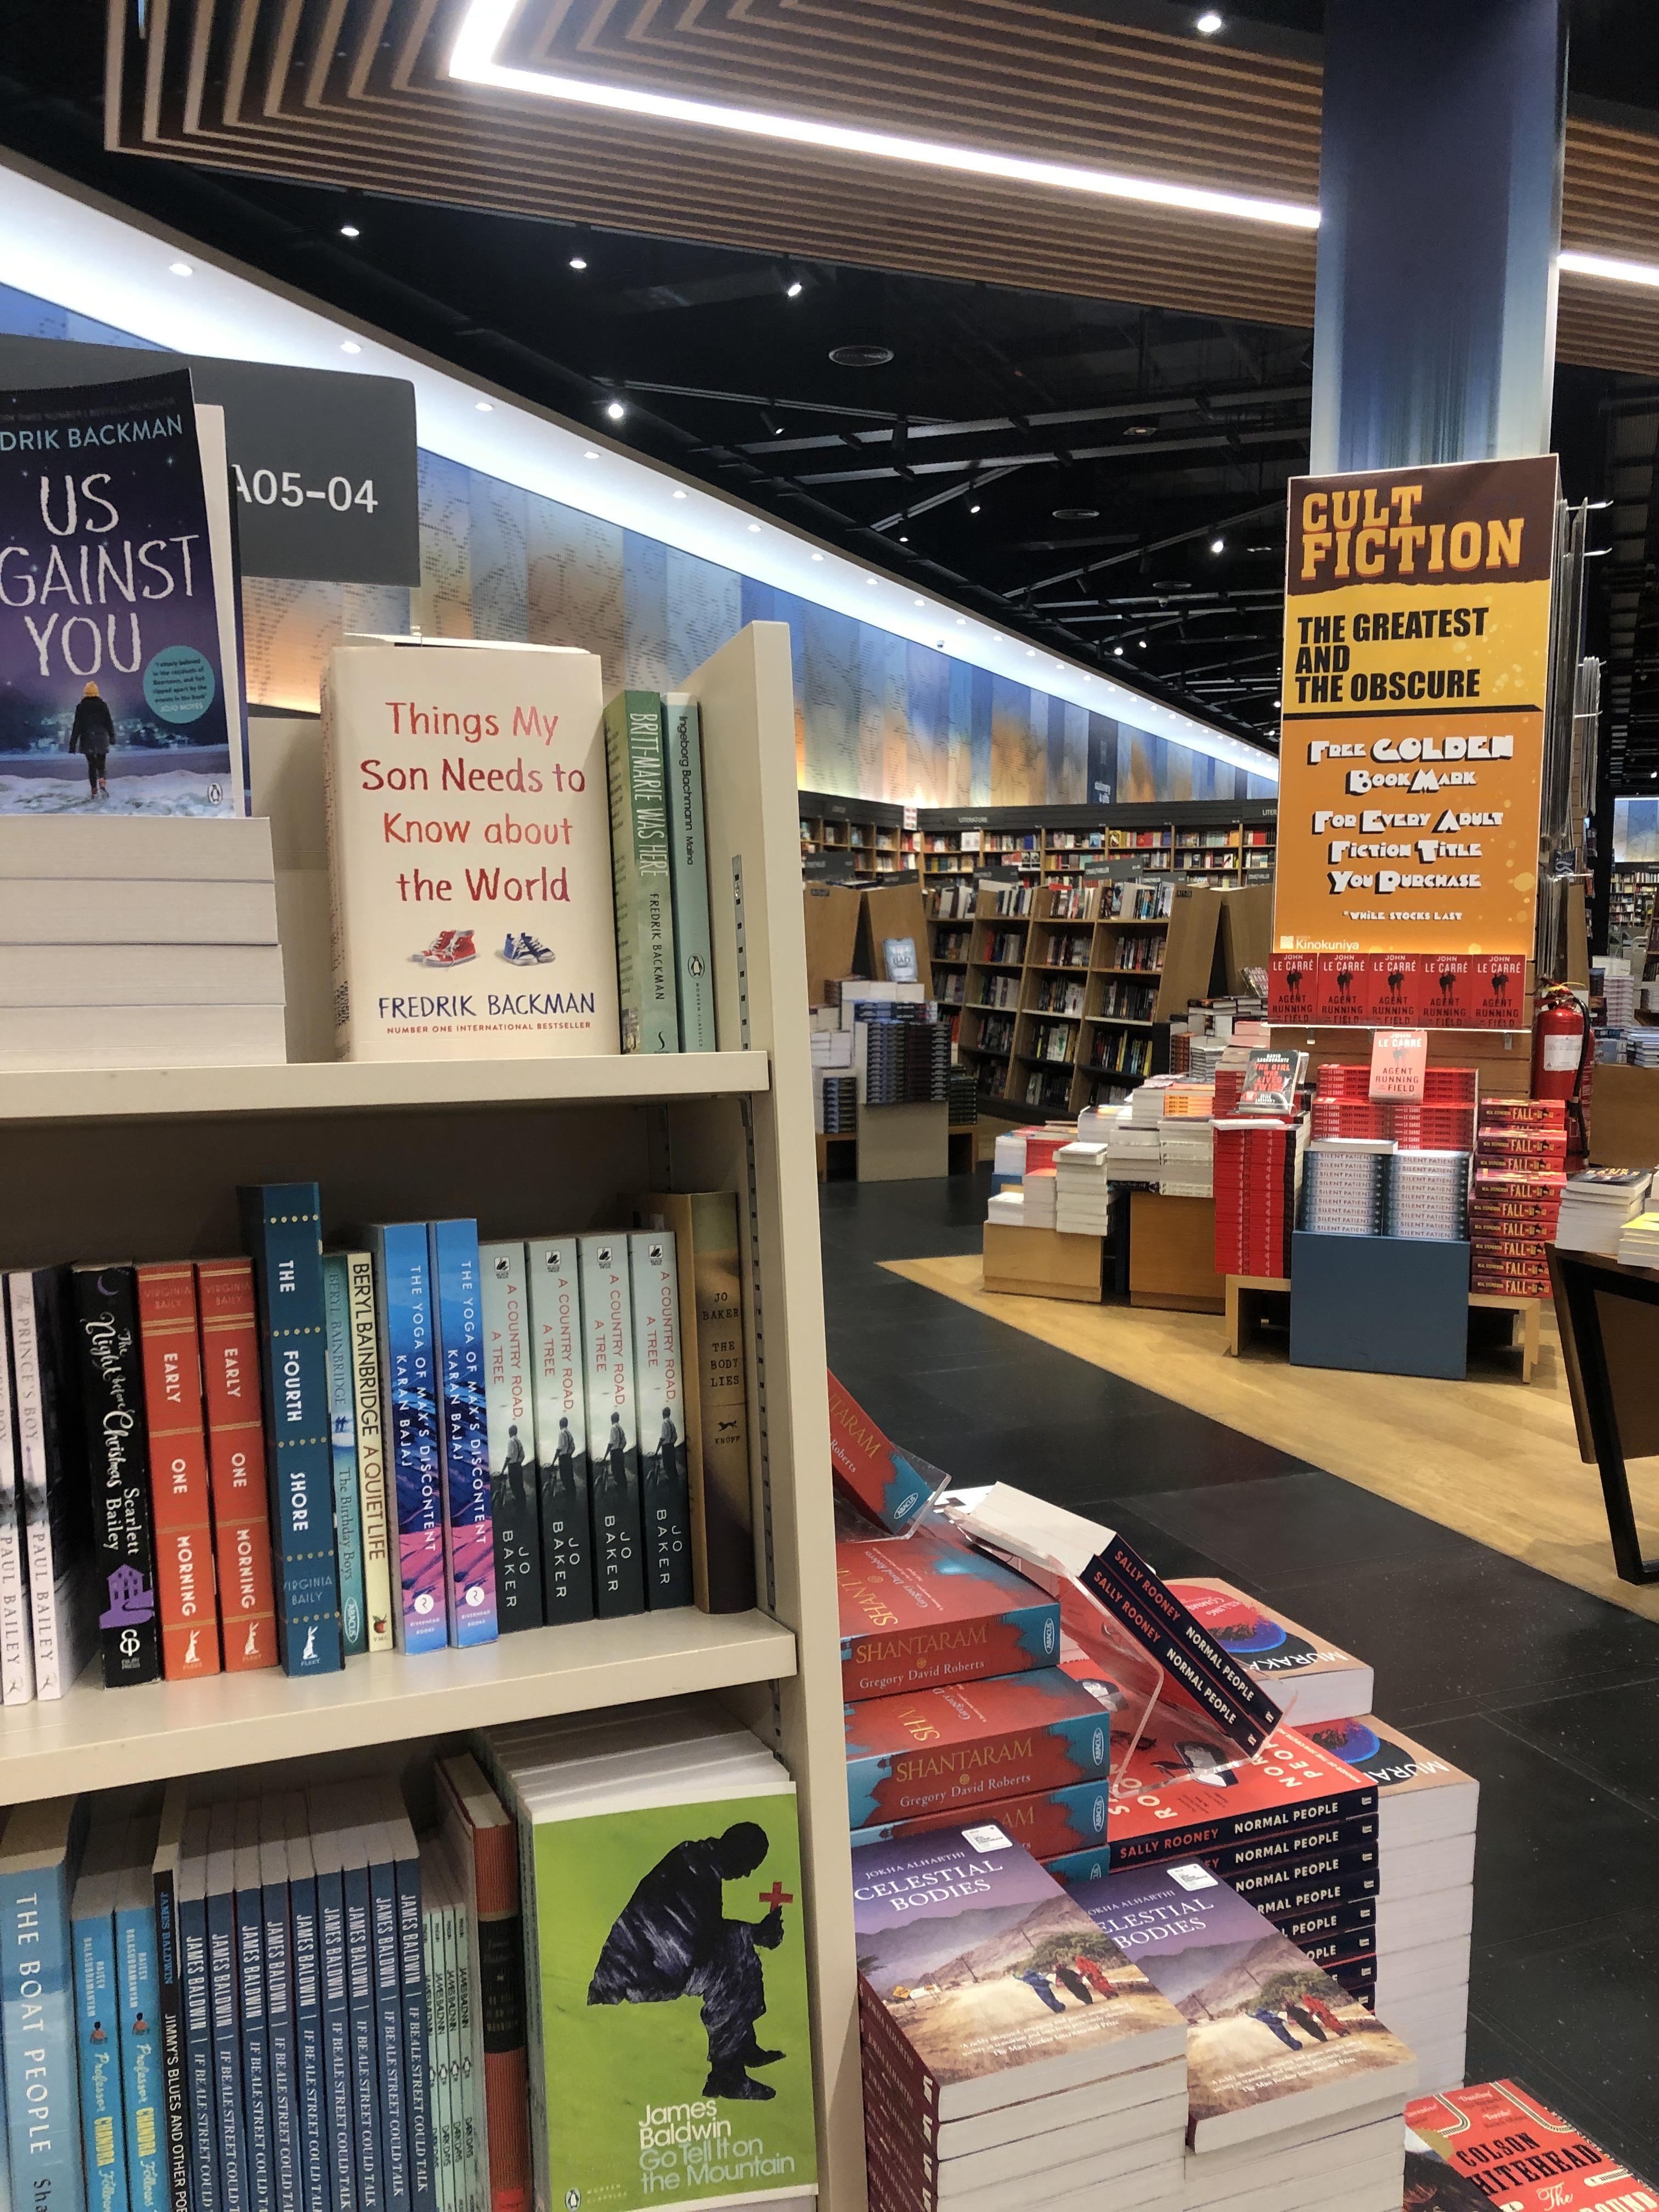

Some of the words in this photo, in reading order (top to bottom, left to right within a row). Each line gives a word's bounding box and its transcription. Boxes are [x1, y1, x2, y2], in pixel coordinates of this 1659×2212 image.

[68, 414, 183, 448] BACKMAN
[40, 473, 119, 536] US
[1302, 485, 1422, 534] CULT
[1301, 517, 1525, 581] FICTION
[24, 612, 141, 676] YOU
[1297, 615, 1345, 644] THE
[1353, 607, 1489, 642] GREATEST
[1295, 645, 1350, 674] AND
[1295, 675, 1343, 703] THE
[1351, 669, 1480, 701] OBSCURE
[385, 701, 499, 743] Things
[512, 706, 558, 746] My
[677, 715, 689, 767] Ingeborg
[630, 713, 662, 801] BRITT-MARIE
[1370, 735, 1513, 763] GOLDEN
[362, 759, 428, 792] Son
[442, 758, 544, 793] Needs
[552, 764, 585, 793] to
[682, 770, 693, 831] Bachmann
[383, 812, 470, 844] Know
[484, 814, 573, 846] about
[636, 808, 665, 839] WAS
[639, 844, 668, 877] HERE
[396, 868, 453, 902] the
[465, 866, 571, 902] World
[1375, 871, 1481, 894] PURCHASE
[650, 893, 661, 940] FREDRIK
[1434, 912, 1462, 921] LAST
[1296, 939, 1359, 952] Kinokuniya
[652, 944, 665, 1000] BACKMAN
[1273, 962, 1284, 971] LE
[1286, 958, 1313, 971] CARRÉ
[379, 995, 477, 1019] FREDRIK
[488, 992, 595, 1015] BACKMAN
[1272, 1005, 1312, 1013] RUNNING
[1278, 995, 1306, 1003] AGENT
[387, 1026, 428, 1034] NUMBER
[432, 1025, 453, 1033] ONE
[456, 1023, 533, 1032] INTERNATIONAL
[537, 1022, 591, 1030] BESTSELLER
[1284, 1014, 1308, 1023] FIELD
[1513, 1108, 1533, 1120] FALL
[279, 1260, 295, 1293] THE
[329, 1273, 341, 1313] BERYL
[353, 1263, 373, 1319] BERYL
[461, 1260, 472, 1290] THE
[661, 1271, 670, 1280] A
[702, 1308, 739, 1320] BAKER
[714, 1293, 727, 1302] JO
[463, 1297, 474, 1344] YOGA
[646, 1317, 656, 1325] A
[661, 1286, 674, 1353] COUNTRY
[80, 1312, 121, 1381] Night
[118, 1328, 133, 1355] The
[647, 1330, 658, 1367] TREE
[712, 1341, 735, 1352] THE
[164, 1352, 180, 1403] EARLY
[330, 1319, 346, 1406] BAINBRIDGE
[356, 1322, 379, 1437] BAINBRIDGE
[448, 1350, 460, 1405] KARAN
[466, 1352, 477, 1372] OF
[664, 1359, 675, 1402] ROAD,
[710, 1359, 738, 1369] BODY
[284, 1350, 302, 1422] FOURTH
[710, 1375, 739, 1387] LIES
[24, 1407, 38, 1440] BOY
[467, 1381, 479, 1431] MAX'S
[103, 1410, 133, 1489] Christmas
[363, 1446, 379, 1459] A
[451, 1413, 463, 1460] BAJAJ
[715, 1435, 741, 1444] KNOPF
[171, 1458, 188, 1494] ONE
[339, 1469, 351, 1493] The
[364, 1462, 383, 1519] QUIET
[470, 1439, 487, 1544] DISCONTENT
[290, 1472, 308, 1532] SHORE
[103, 1498, 123, 1550] Bailey
[123, 1487, 142, 1555] Scarlett
[339, 1497, 354, 1549] Birthday
[671, 1526, 682, 1552] JO
[33, 1533, 47, 1583] PAUL
[368, 1525, 385, 1561] LIFE
[656, 1509, 670, 1585] BAKER
[177, 1536, 196, 1616] MORNING
[340, 1551, 354, 1581] Boys
[292, 1592, 323, 1606] BAILY
[36, 1592, 53, 1660] BAILEY
[856, 1625, 987, 1664] SHANTARAM
[859, 1673, 904, 1689] Gregory
[909, 1667, 940, 1681] David
[944, 1660, 985, 1674] Roberts
[1120, 1841, 1159, 1860] SALLY
[1164, 1829, 1218, 1850] ROONEY
[1234, 1812, 1289, 1835] NORMAL
[1293, 1801, 1339, 1822] PEOPLE
[854, 1860, 1003, 1901] CELESTIAL
[865, 1865, 904, 1880] JOKHA
[907, 1852, 965, 1870] ALHARTHI
[161, 1892, 170, 1929] JAMES
[401, 1895, 417, 1931] JAMES
[889, 1879, 991, 1911] BODIES
[16, 1892, 39, 1945] THE
[162, 1932, 173, 1984] BALDWIN
[403, 1933, 421, 1984] BALDWIN
[20, 1961, 44, 2031] BOAT
[409, 2007, 419, 2019] IF
[165, 2014, 178, 2065] JIMMY'S
[409, 2022, 421, 2062] BEALE
[1008, 2044, 1026, 2052] Man
[1101, 2021, 1119, 2029] Prize
[24, 2048, 51, 2154] PEOPLE
[168, 2068, 181, 2111] BLUES
[411, 2064, 424, 2113] STREET
[171, 2115, 183, 2141] AND
[639, 2100, 716, 2128] James
[414, 2115, 426, 2157] COULD
[640, 2117, 731, 2150] Baldwin
[1455, 2132, 1541, 2167] COLSON
[172, 2146, 185, 2188] OTHER
[639, 2148, 677, 2171] Go
[679, 2140, 712, 2165] Tell
[716, 2137, 730, 2160] It
[732, 2138, 763, 2157] on
[1466, 2144, 1601, 2196] HITEHEAD
[417, 2158, 428, 2193] TALK
[641, 2172, 680, 2194] the
[687, 2153, 795, 2186] Mountain
[1537, 2182, 1573, 2211] The
